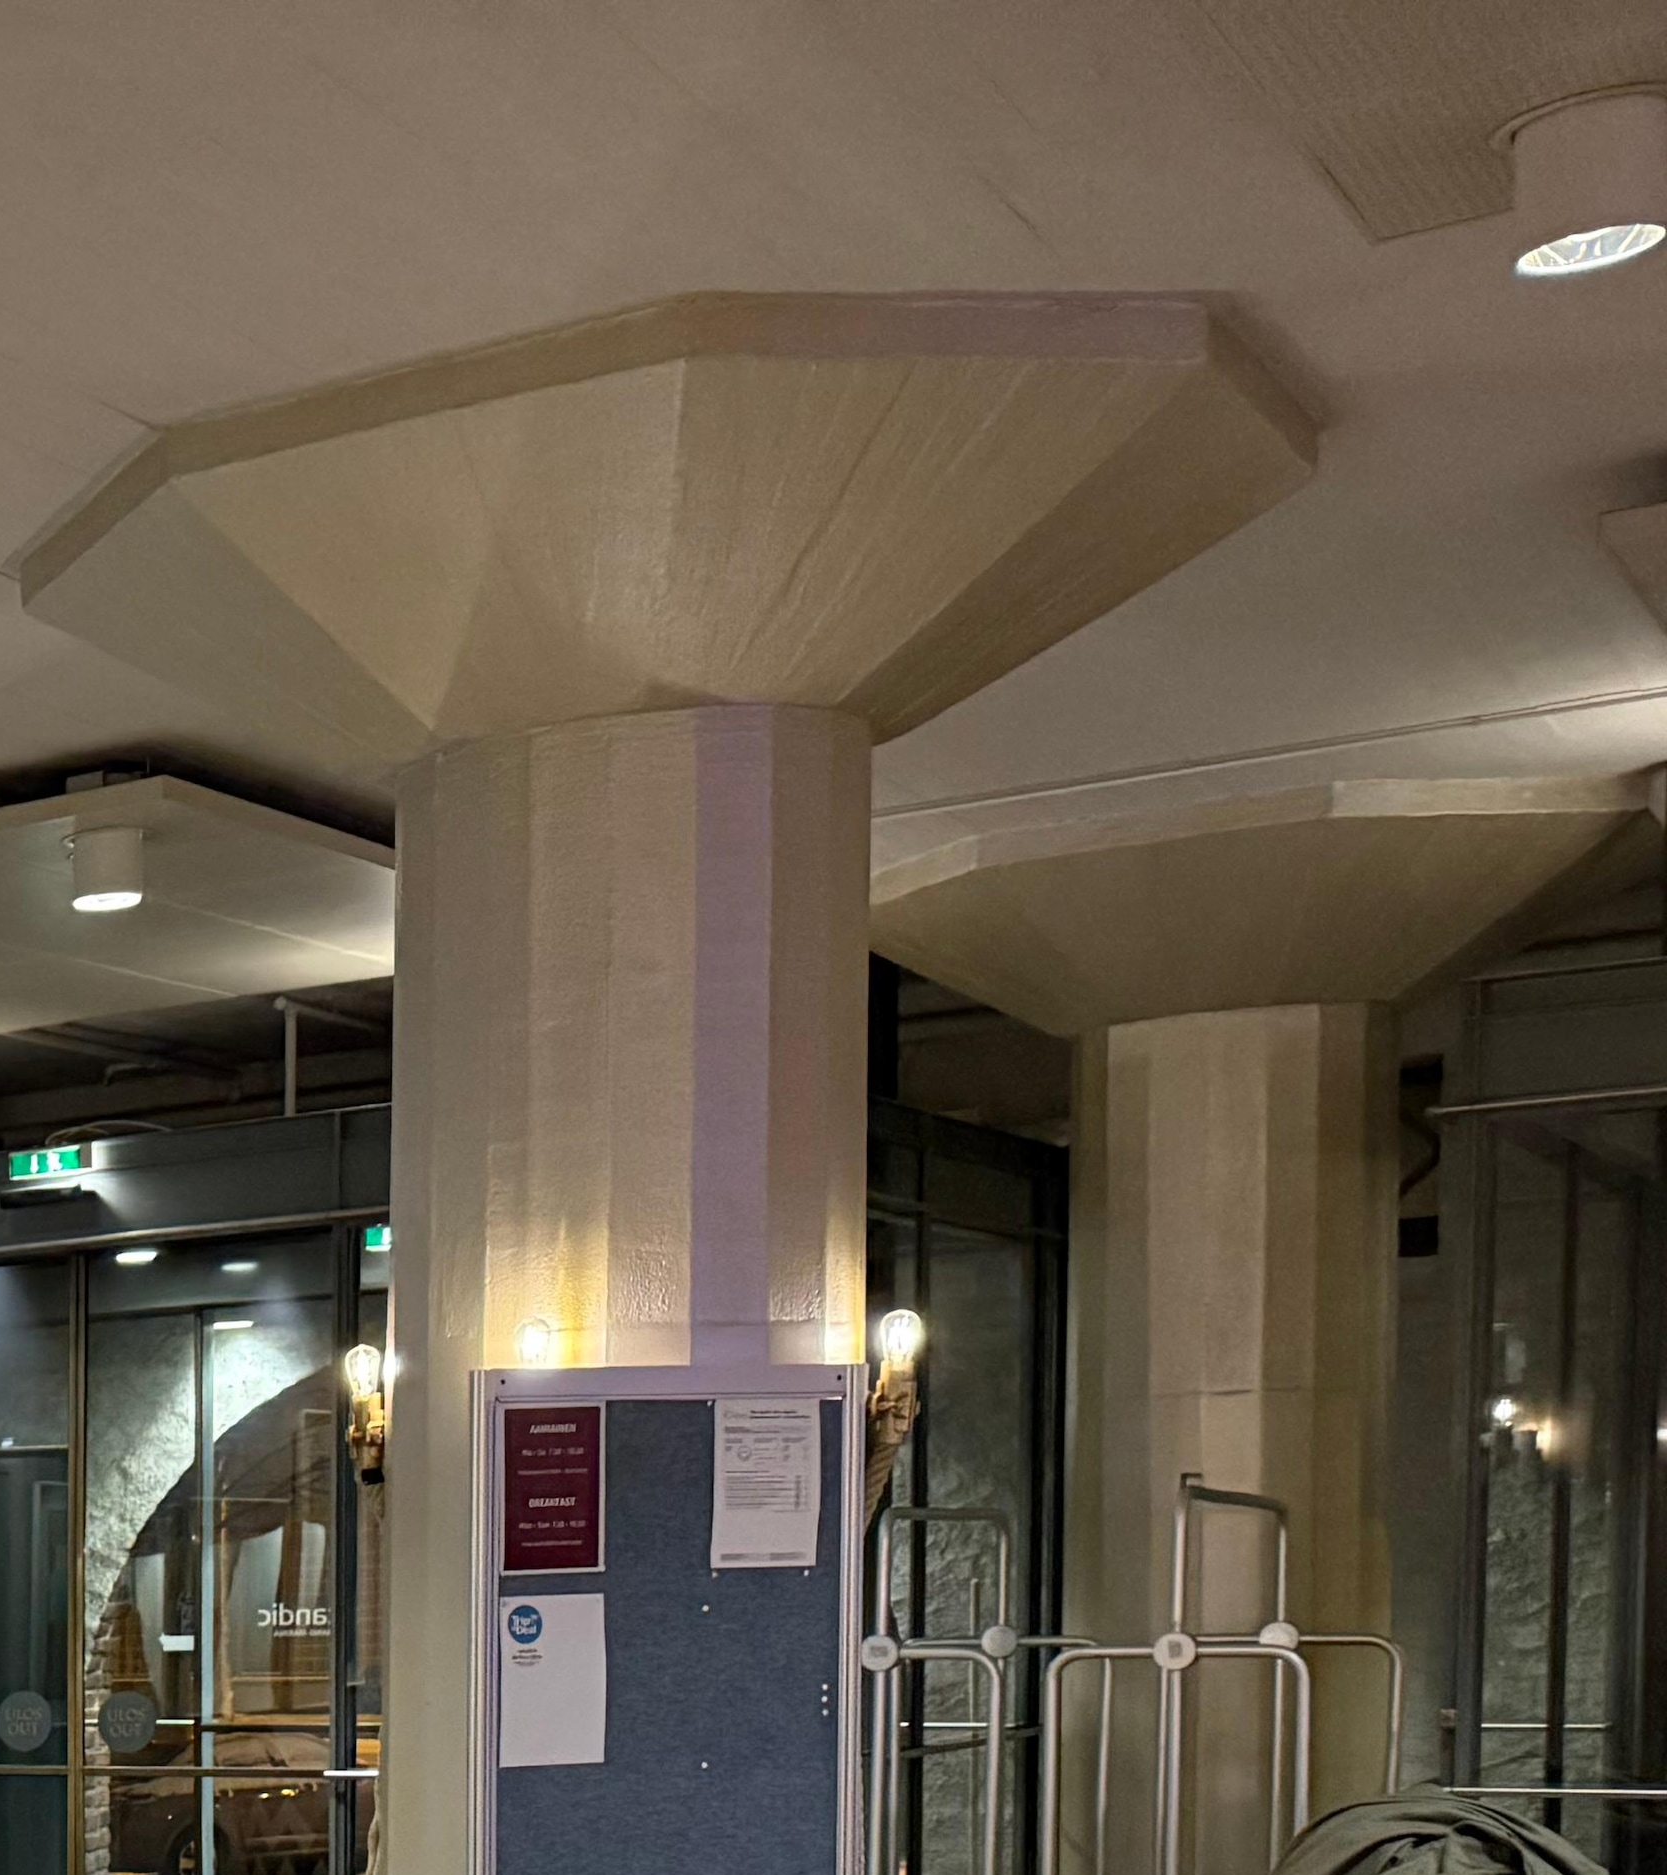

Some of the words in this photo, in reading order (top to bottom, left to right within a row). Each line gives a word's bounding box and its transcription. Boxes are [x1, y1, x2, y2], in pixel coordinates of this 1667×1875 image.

[5, 1706, 43, 1721] ULOS
[107, 1706, 146, 1722] ULOS
[7, 1721, 38, 1737] OUT
[109, 1722, 142, 1738] OUT
